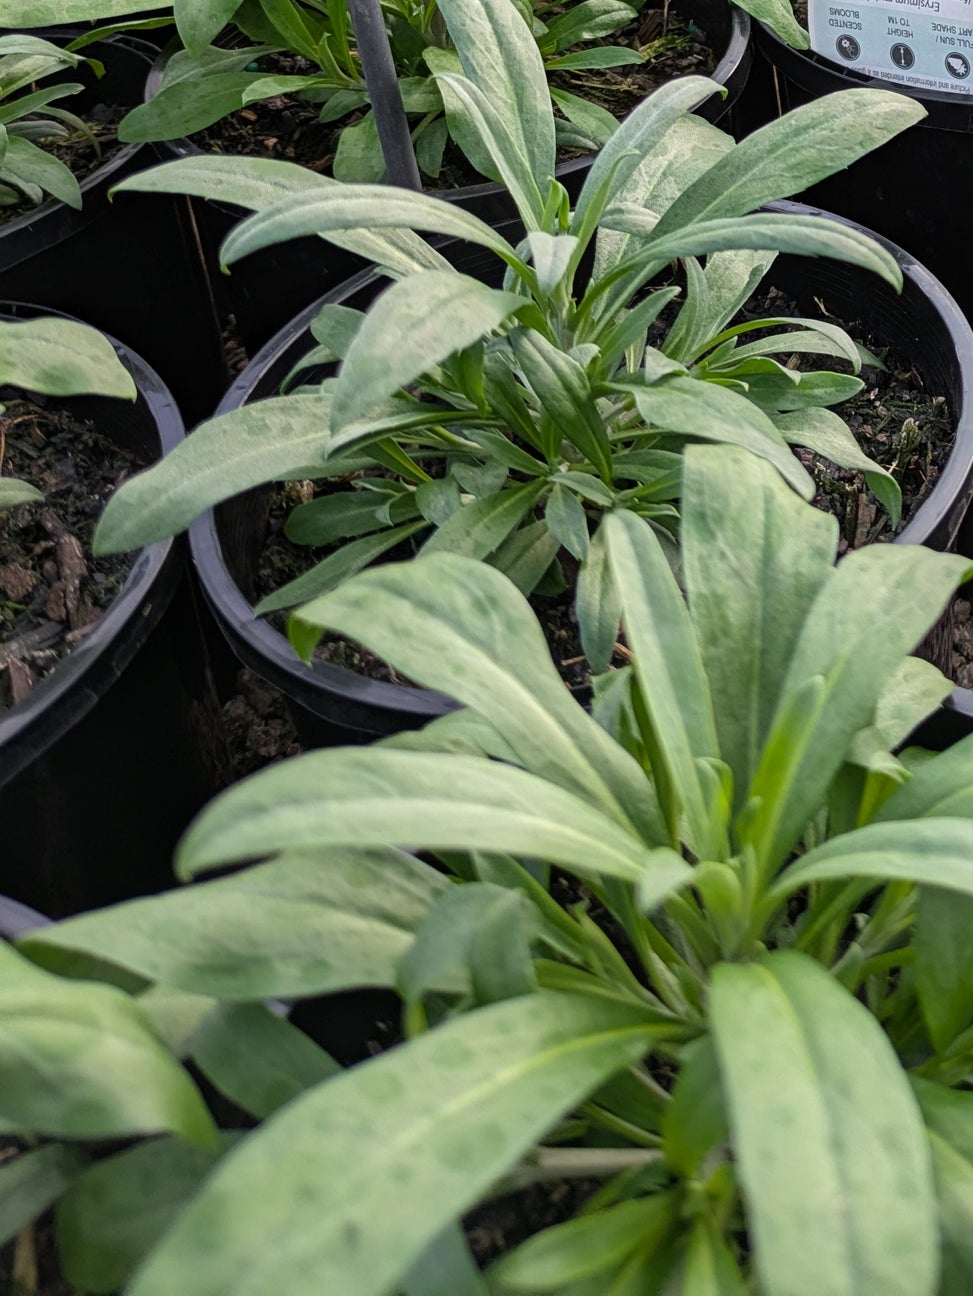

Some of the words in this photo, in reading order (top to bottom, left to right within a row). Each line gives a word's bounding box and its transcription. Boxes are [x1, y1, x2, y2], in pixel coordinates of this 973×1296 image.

[829, 8, 859, 18] BLOOMS
[828, 18, 862, 30] SCENTED
[888, 16, 898, 24] 1M
[899, 18, 910, 26] TO
[886, 27, 914, 39] HEIGHT
[931, 22, 956, 34] SHADE
[939, 36, 955, 46] SUN
[957, 37, 973, 48] FULL
[880, 72, 904, 81] intended
[906, 76, 937, 88] information
[938, 81, 949, 89] and
[950, 83, 971, 94] Picture
